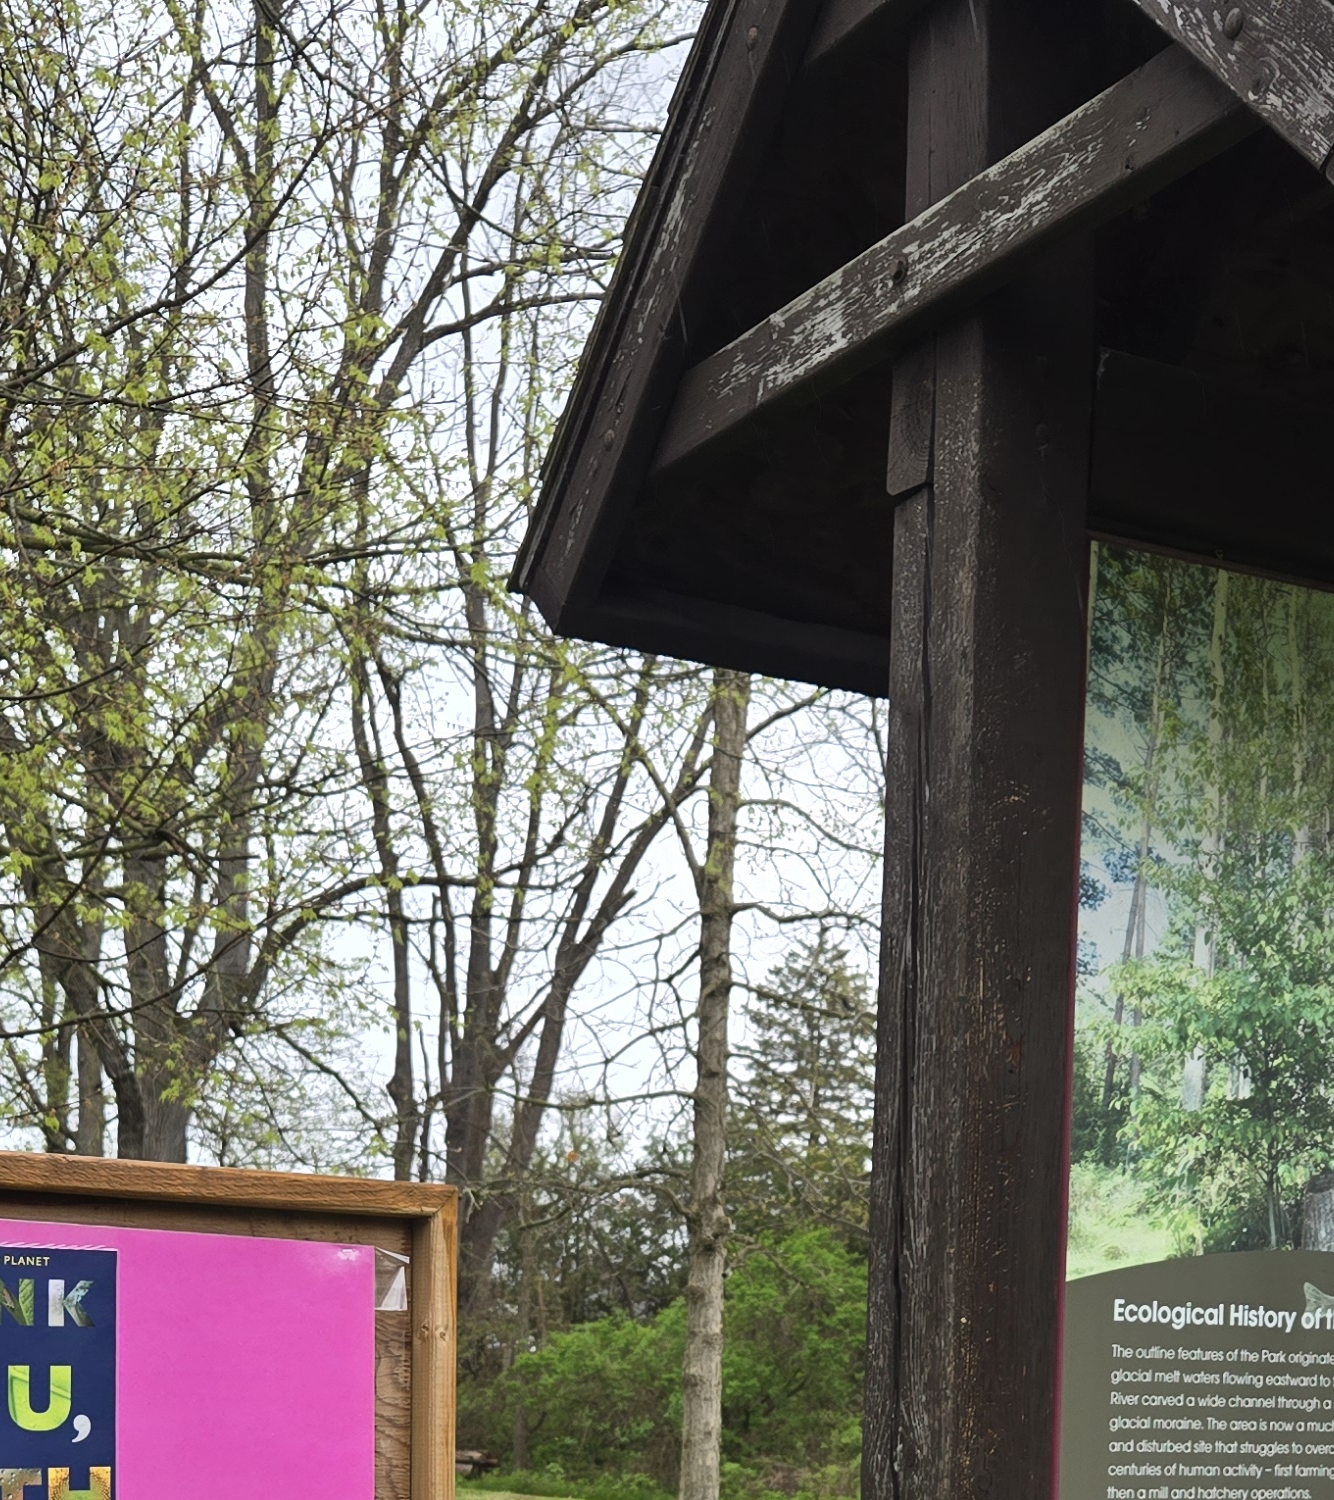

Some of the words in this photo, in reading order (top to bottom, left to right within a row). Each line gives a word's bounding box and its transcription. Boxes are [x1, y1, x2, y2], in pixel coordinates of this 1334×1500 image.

[4, 1255, 50, 1266] PLANET
[1113, 1298, 1224, 1329] Ecological
[1229, 1303, 1296, 1332] History
[1300, 1307, 1324, 1330] of
[1111, 1343, 1133, 1358] The
[1135, 1345, 1175, 1359] outline
[1177, 1346, 1224, 1361] features
[1225, 1348, 1238, 1361] of
[1239, 1349, 1259, 1362] the
[1261, 1349, 1286, 1362] Park
[1110, 1368, 1152, 1384] glacial
[1154, 1370, 1180, 1382] melt
[1182, 1370, 1220, 1384] waters
[1222, 1371, 1263, 1388] flowing
[1265, 1373, 1317, 1386] eastward
[1319, 1374, 1331, 1387] to
[1109, 1391, 1139, 1405] River
[1141, 1393, 1184, 1406] carved
[1185, 1396, 1195, 1406] a
[1197, 1393, 1226, 1407] wide
[1227, 1394, 1275, 1408] channel
[1277, 1395, 1320, 1412] through
[1322, 1399, 1331, 1409] a
[1108, 1415, 1150, 1431] glacial
[1152, 1416, 1204, 1429] moraine.
[1206, 1417, 1227, 1430] The
[1229, 1420, 1257, 1430] area
[1258, 1418, 1267, 1431] is
[1269, 1420, 1294, 1431] now
[1295, 1421, 1304, 1431] a
[1108, 1439, 1134, 1452] and
[1136, 1439, 1191, 1453] disturbed
[1193, 1440, 1212, 1453] site
[1214, 1440, 1238, 1453] that
[1239, 1441, 1289, 1457] struggles
[1291, 1441, 1303, 1454] to
[1107, 1462, 1161, 1476] centuries
[1163, 1462, 1176, 1476] of
[1178, 1463, 1220, 1476] human
[1222, 1463, 1263, 1479] activity
[1273, 1463, 1292, 1476] first
[1106, 1485, 1134, 1499] then
[1136, 1488, 1146, 1499] a
[1148, 1486, 1168, 1498] mill
[1170, 1486, 1195, 1499] and
[1197, 1486, 1248, 1500] hatchery
[1250, 1486, 1311, 1500] operations.
